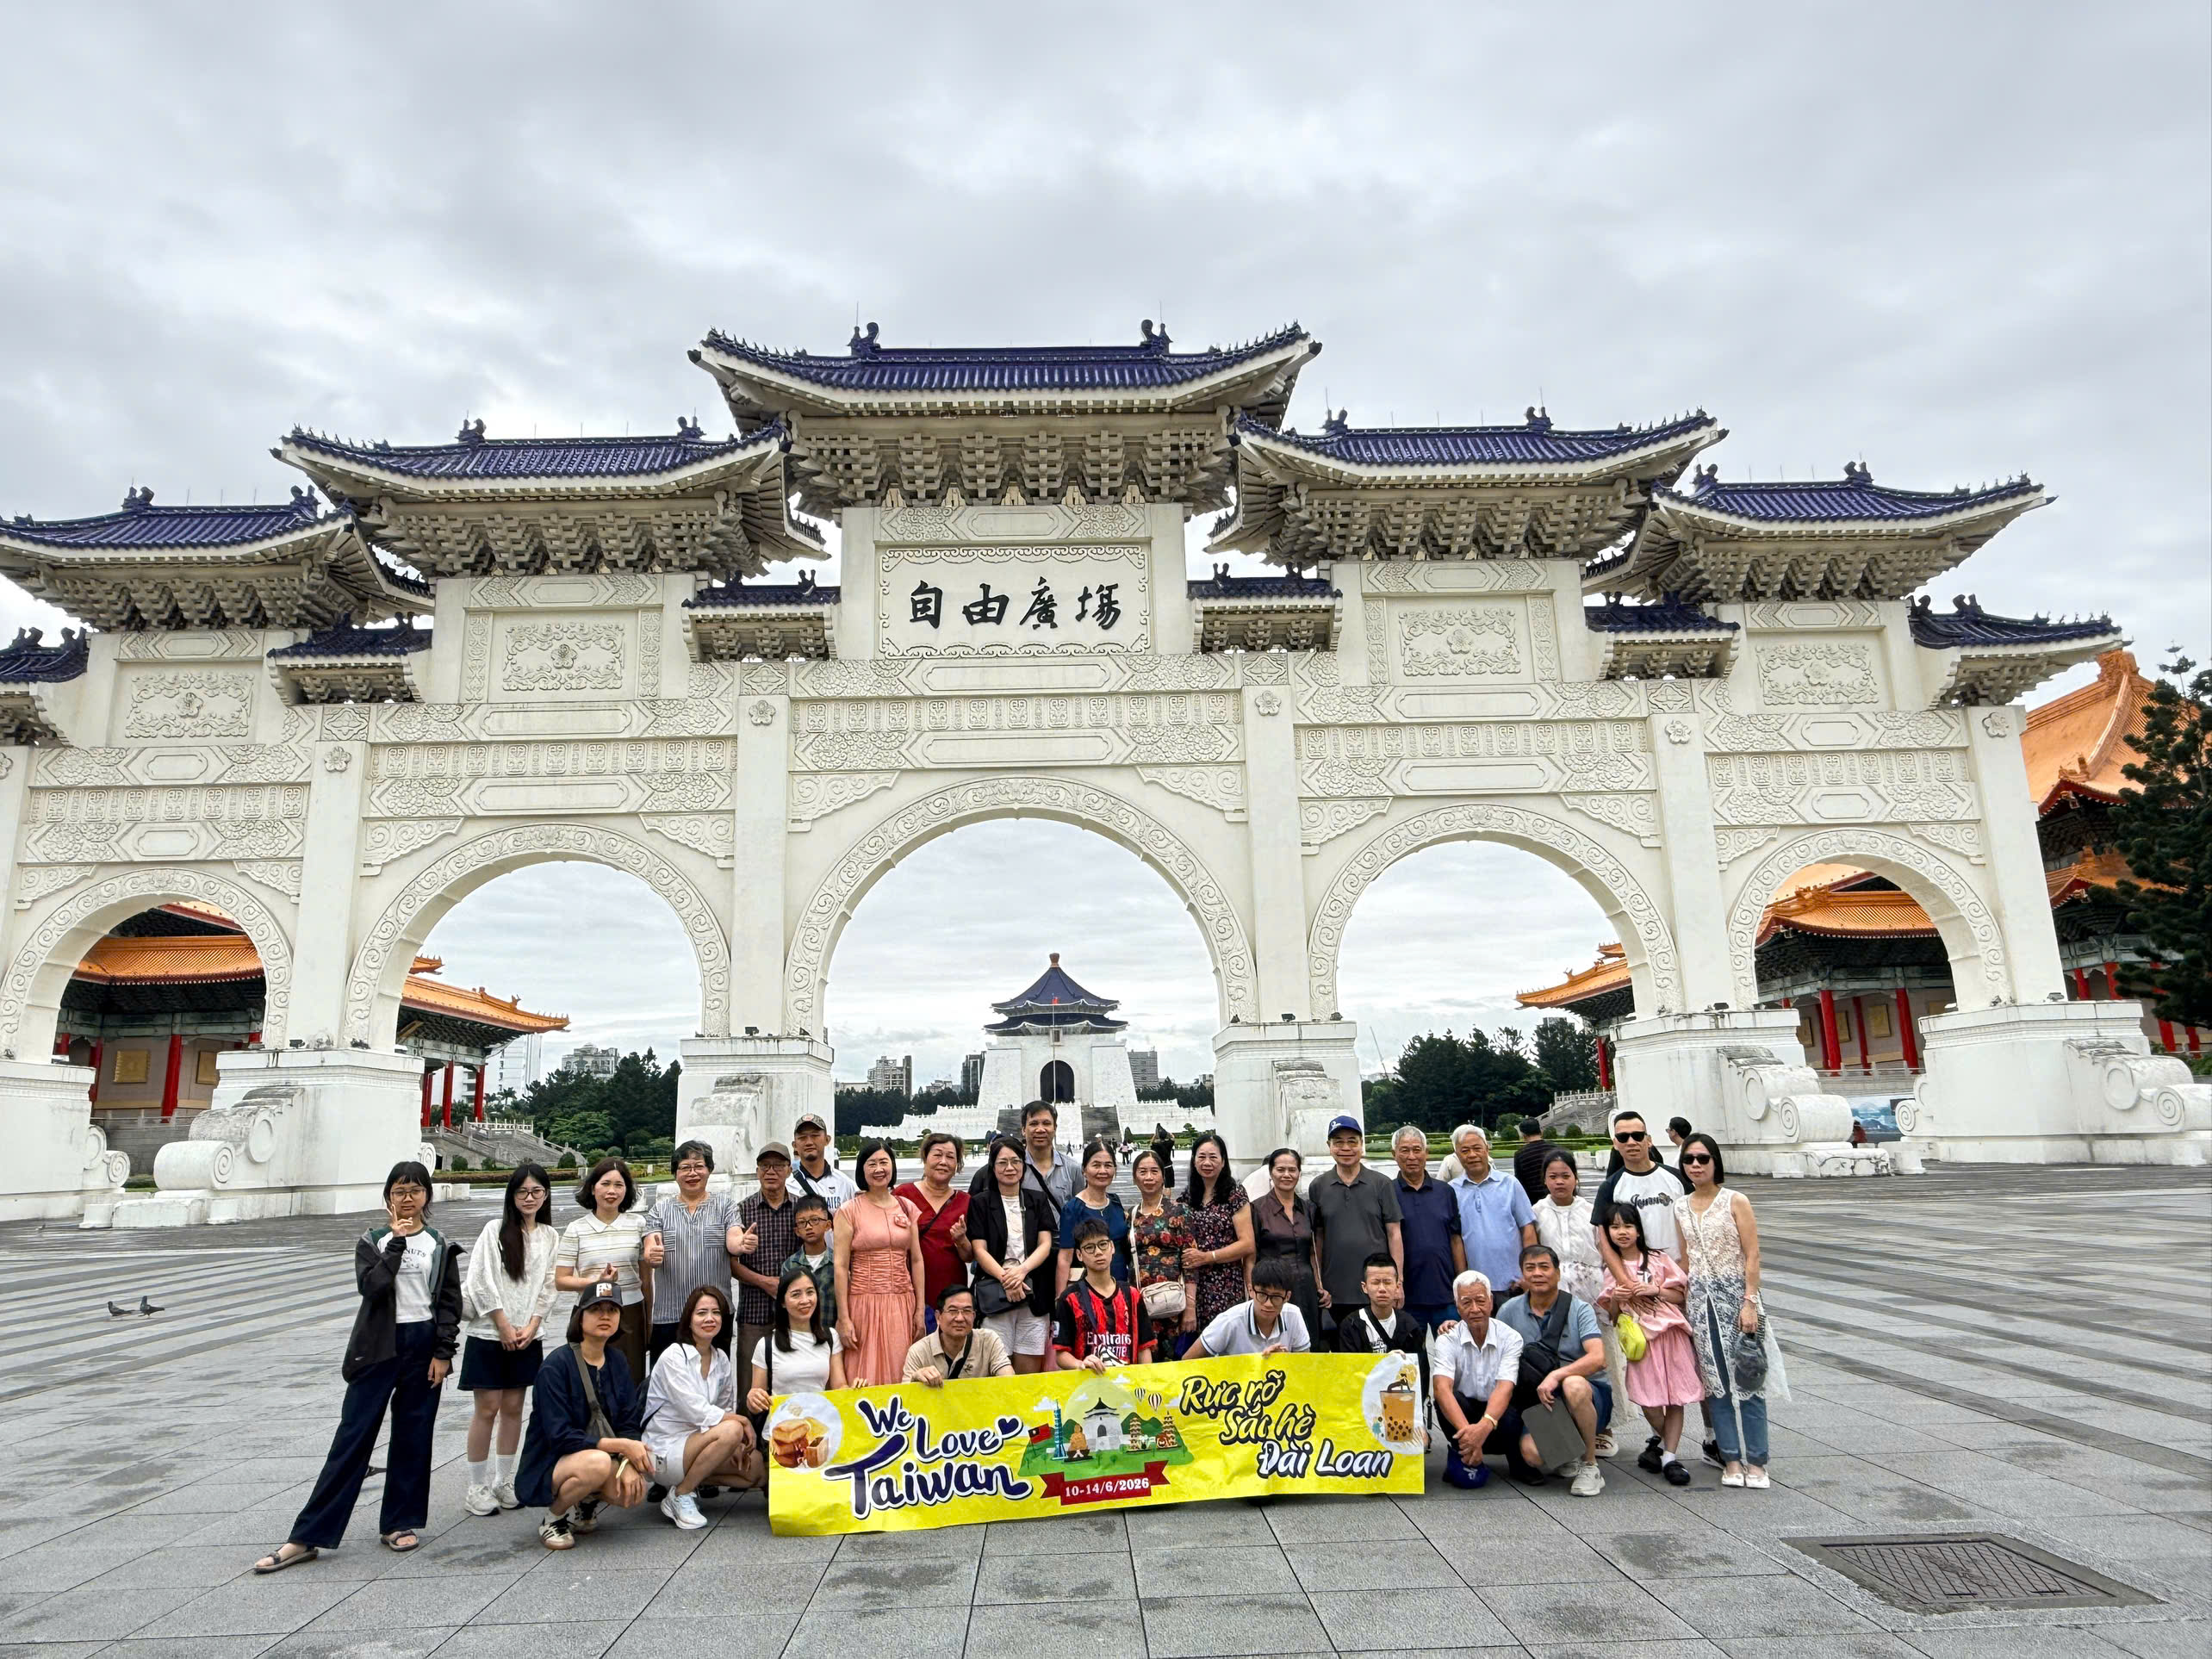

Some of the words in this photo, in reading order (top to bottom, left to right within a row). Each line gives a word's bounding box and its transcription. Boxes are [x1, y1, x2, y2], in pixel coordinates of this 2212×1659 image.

[402, 1247, 426, 1258] NUTS
[857, 1395, 914, 1435] We
[1181, 1376, 1241, 1419] Rực
[1245, 1370, 1285, 1406] rỡ
[916, 1415, 1000, 1461] Love
[1220, 1399, 1272, 1445] Sắc
[1275, 1403, 1316, 1442] hè
[825, 1432, 1031, 1517] Taiwan
[1258, 1439, 1313, 1478] Đài
[1315, 1438, 1394, 1478] Loan
[1065, 1477, 1150, 1497] 10-14/6/2026
